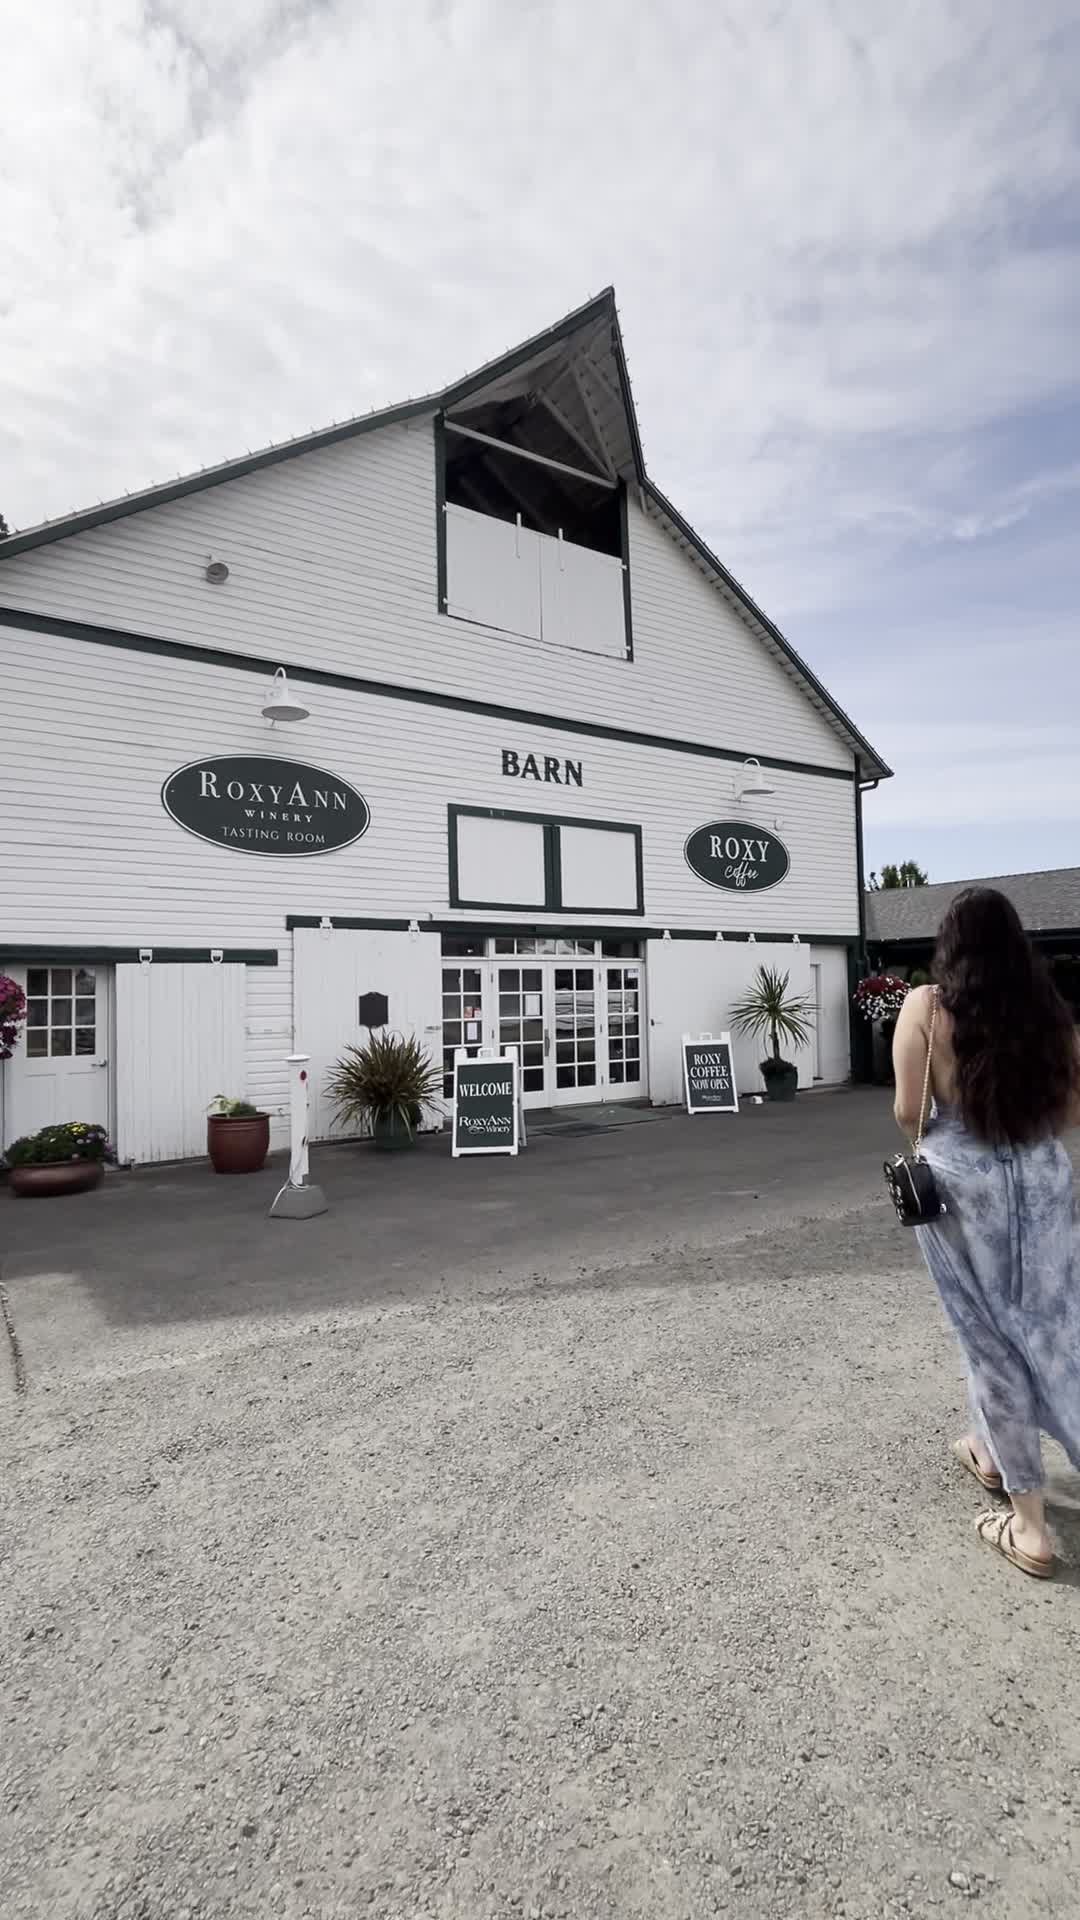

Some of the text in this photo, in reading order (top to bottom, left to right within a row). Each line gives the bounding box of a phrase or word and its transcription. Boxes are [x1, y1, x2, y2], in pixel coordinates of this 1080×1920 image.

[501, 749, 583, 787] BARN
[244, 808, 313, 824] WINERY
[221, 826, 326, 844] TASTING ROOM
[709, 834, 770, 863] ROXY
[693, 1052, 721, 1066] ROXY
[690, 1065, 729, 1078] COFFEE
[459, 1082, 512, 1097] WELCOME
[691, 1078, 730, 1090] NOW OPEN
